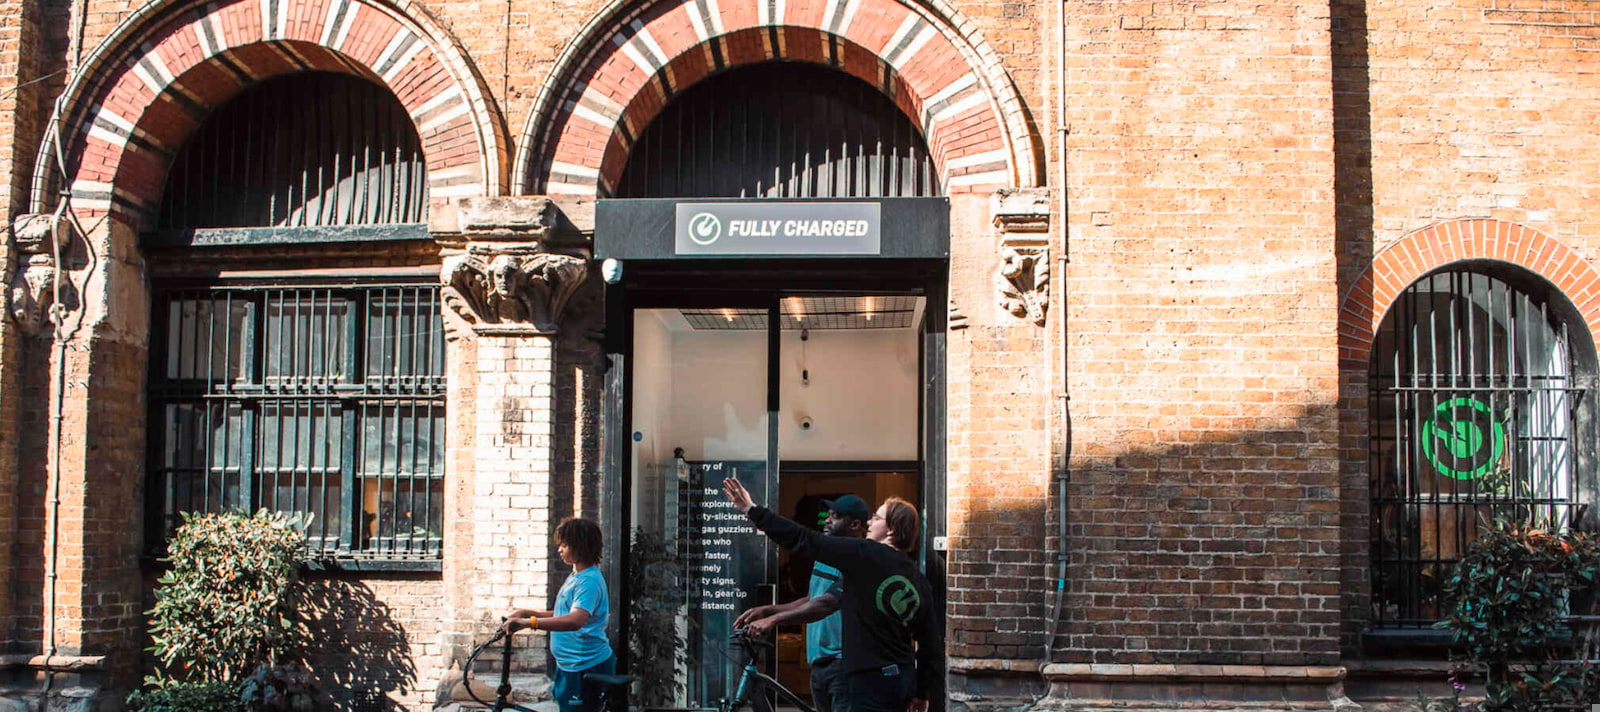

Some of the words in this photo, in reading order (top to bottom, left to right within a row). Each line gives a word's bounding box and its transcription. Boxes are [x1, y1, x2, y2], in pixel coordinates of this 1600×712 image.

[728, 220, 781, 237] FULLY
[784, 220, 869, 237] CHARGED
[713, 462, 722, 470] of
[704, 487, 718, 495] the
[702, 526, 716, 534] gas
[718, 525, 754, 534] guzzlers
[714, 538, 732, 546] who
[704, 552, 732, 560] faster,
[712, 576, 736, 586] signs.
[715, 591, 734, 599] gear
[736, 589, 747, 598] up
[700, 602, 735, 610] distance
